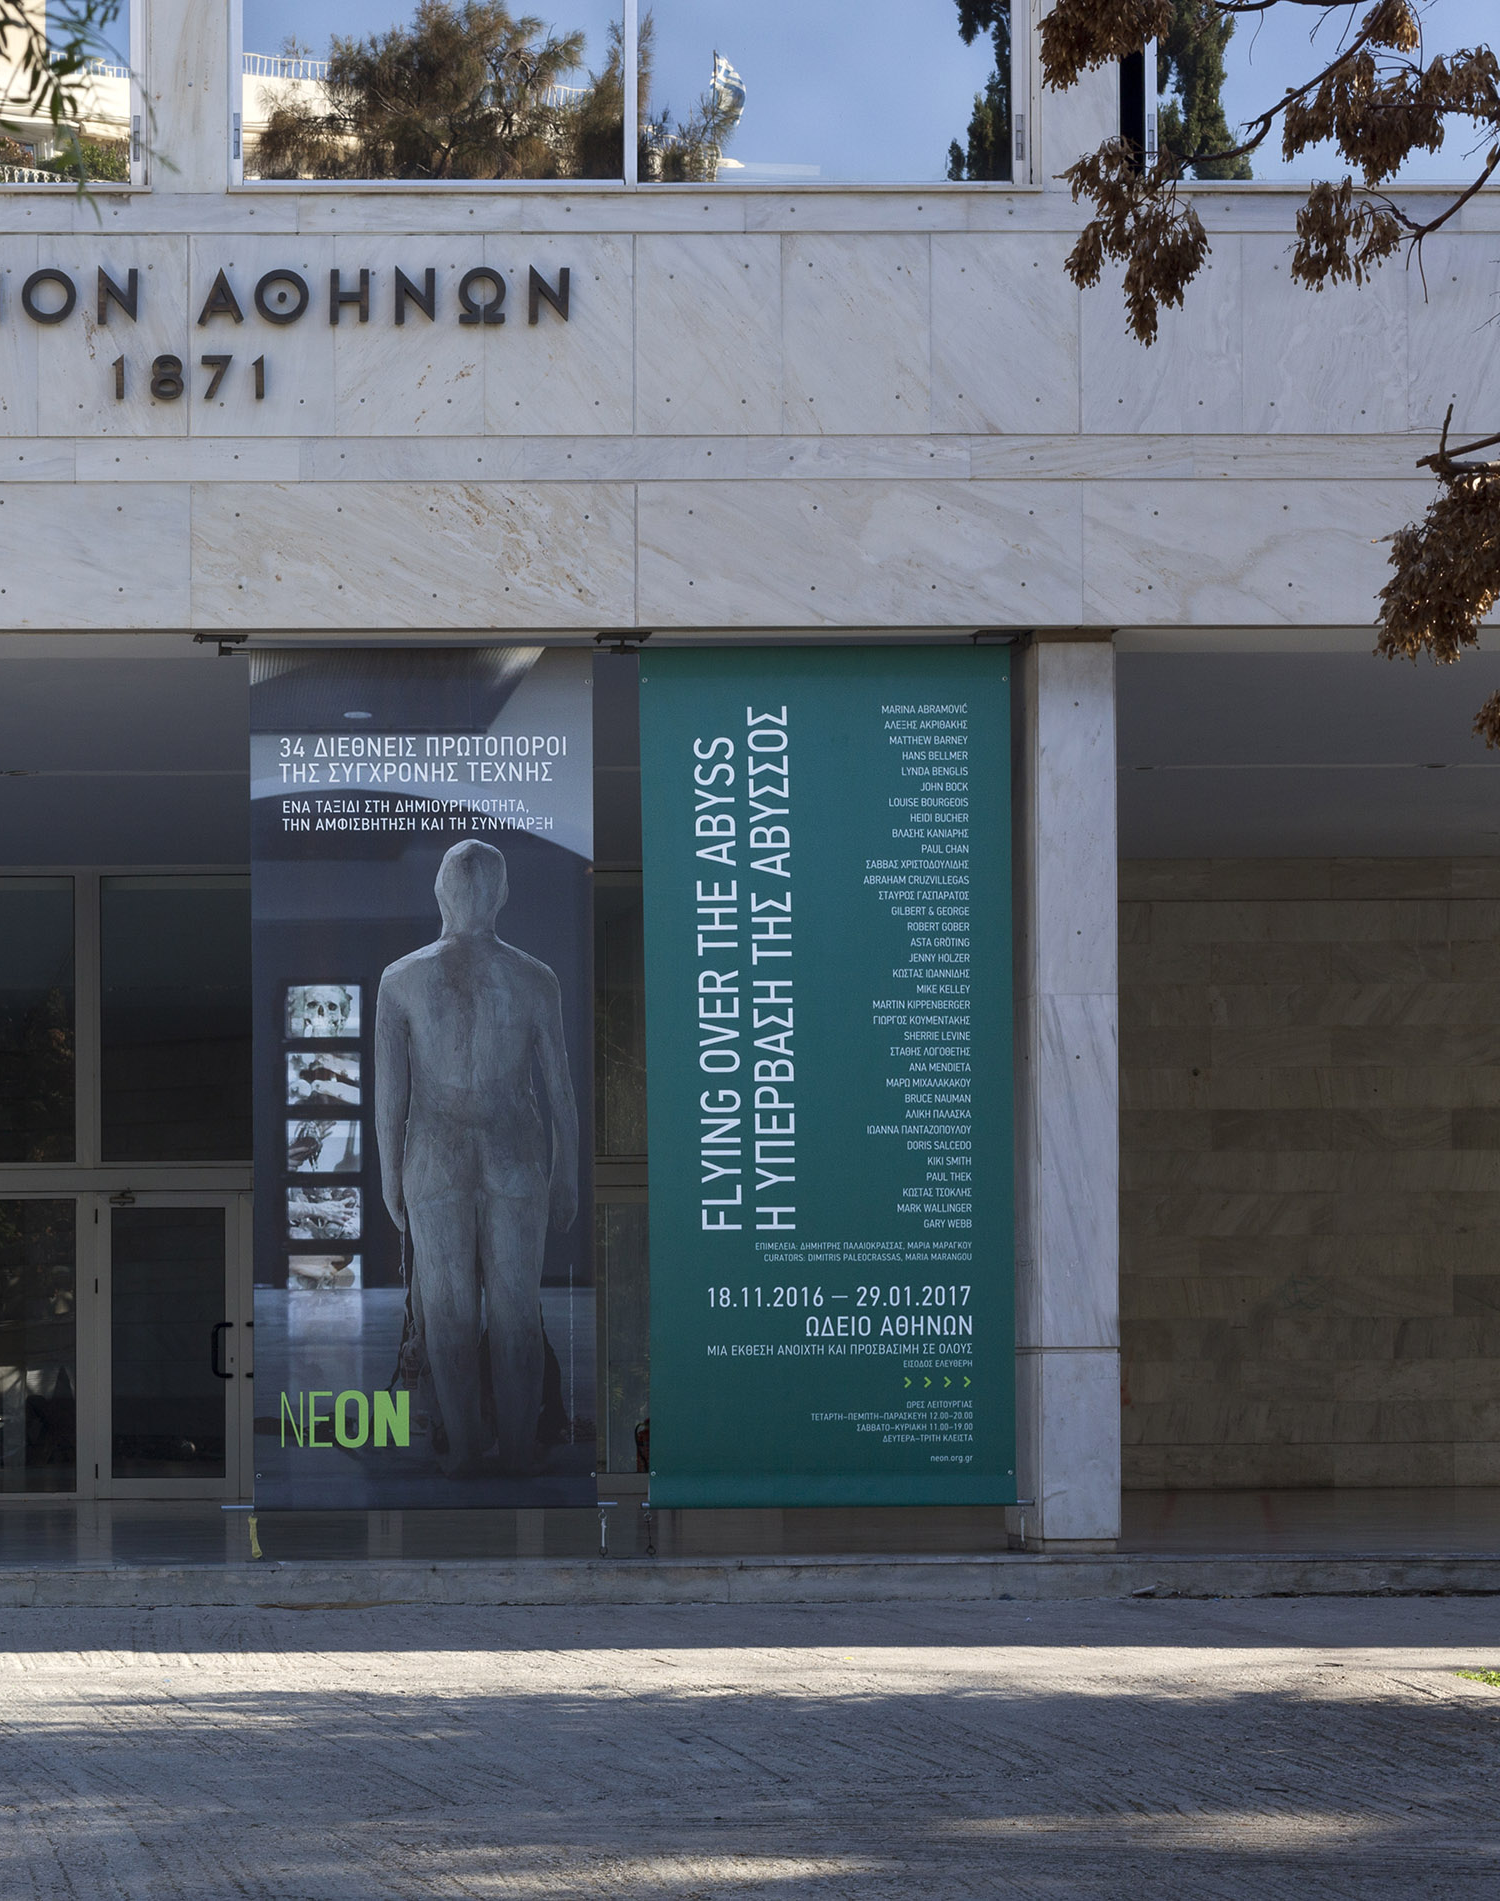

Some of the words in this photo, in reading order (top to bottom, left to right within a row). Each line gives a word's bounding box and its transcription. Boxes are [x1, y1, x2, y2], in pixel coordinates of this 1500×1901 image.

[197, 265, 570, 325] ΑΘΗΝΩΝ
[111, 354, 266, 400] 1871
[881, 704, 916, 714] MARINA
[917, 702, 968, 714] ABRAMOVIĆ
[883, 719, 918, 730] ΑΛΕΞΗΣ
[919, 719, 968, 730] ΑΚΡΙΘΑΚΗΣ
[889, 735, 932, 745] MATTHEW
[933, 735, 969, 745] BARNEY
[279, 737, 306, 758] 34
[313, 736, 417, 758] ΔΙΕΘΝΕΙΣ
[426, 735, 567, 757] ΠΡΩΤΟΠΟΡΟΙ
[902, 750, 927, 761] HANS
[928, 750, 969, 761] BELLMER
[278, 762, 321, 784] ΤΗΣ
[328, 762, 459, 783] ΣΥΓΧΡΟΝΗΣ
[466, 761, 553, 782] ΤΕΧΝΗΣ
[901, 766, 931, 777] LYNDA
[931, 766, 969, 777] BENGLIS
[747, 705, 791, 878] ΑΒΥΣΣΟΣ
[920, 781, 944, 792] JOHN
[945, 781, 969, 792] BOCK
[282, 800, 311, 814] ΕΝΑ
[315, 799, 360, 814] ΤΑΞΙΔΙ
[364, 799, 390, 813] ΣΤΗ
[394, 799, 530, 814] ΔΗΜΙΟΥΡΓΙΚΟΤΗΤΑ,
[693, 736, 736, 867] ABYSS
[888, 797, 919, 808] LOUISE
[920, 797, 969, 808] BOURGEOIS
[909, 812, 933, 823] HEIDI
[934, 812, 970, 823] BUCHER
[281, 818, 310, 832] ΤΗΝ
[315, 817, 416, 831] ΑΜΦΙΣΒΗΤΗΣΗ
[421, 817, 444, 831] ΚΑΙ
[448, 816, 467, 831] ΤΗ
[471, 816, 554, 830] ΣΥΝΥΠΑΡΞΗ
[891, 828, 925, 839] ΒΛΑΣΗΣ
[926, 828, 969, 839] ΚΑΝΙΑΡΗΣ
[921, 843, 944, 854] PAUL
[945, 844, 970, 854] CHAN
[865, 859, 899, 870] ΣΑΒΒΑΣ
[900, 859, 970, 870] ΧΡΙΣΤΟΔΟΥΛΙΔΗΣ
[863, 875, 907, 885] ABRAHAM
[907, 874, 970, 885] CRUZVILLEGAS
[878, 890, 915, 901] ΣΤΑΥΡΟΣ
[916, 890, 970, 901] ΓΑΣΠΑΡΑΤΟΣ
[890, 906, 927, 916] GILBERT
[927, 906, 935, 916] &
[936, 906, 970, 917] GEORGE
[696, 880, 738, 956] THE
[751, 892, 792, 965] ΤΗΣ
[907, 921, 940, 932] ROBERT
[941, 921, 970, 932] GOBER
[910, 937, 933, 948] ASTA
[933, 936, 971, 948] GRÖTING
[908, 953, 937, 963] JENNY
[937, 952, 971, 963] HOLZER
[892, 968, 924, 979] ΚΩΣΤΑΣ
[925, 968, 970, 979] ΙΩΑΝΝΙΔΗΣ
[916, 984, 938, 994] MIKE
[939, 984, 971, 994] KELLEY
[872, 999, 906, 1009] MARTIN
[907, 999, 971, 1010] KIPPENBERGER
[698, 969, 741, 1073] OVER
[872, 1015, 908, 1025] ΓΙΩΡΓΟΣ
[909, 1015, 971, 1026] ΚΟΥΜΕΝΤΑΚΗΣ
[903, 1030, 940, 1041] SHERRIE
[941, 1031, 971, 1041] LEVINE
[890, 1046, 922, 1057] ΣΤΑΘΗΣ
[922, 1046, 971, 1057] ΛΟΓΟΘΕΤΗΣ
[908, 1062, 928, 1072] ANA
[928, 1062, 972, 1072] MENDIETA
[753, 980, 796, 1191] ΥΠΕΡΒΑΣΗ
[885, 1077, 911, 1088] ΜΑΡΩ
[912, 1078, 972, 1088] ΜΙΧΑΛΑΚΑΚΟΥ
[904, 1093, 933, 1104] BRUCE
[934, 1093, 972, 1104] NAUMAN
[905, 1109, 932, 1119] ΑΛΙΚΗ
[932, 1109, 972, 1119] ΠΑΛΑΣΚΑ
[866, 1124, 900, 1135] ΙΩΑΝΝΑ
[901, 1124, 972, 1135] ΠΑΝΤΑΖΟΠΟΥΛΟΥ
[906, 1140, 933, 1151] DORIS
[933, 1140, 972, 1151] SALCEDO
[700, 1089, 742, 1231] FLYING
[927, 1156, 944, 1166] KIKI
[945, 1156, 972, 1166] SMITH
[926, 1171, 949, 1182] PAUL
[949, 1171, 972, 1182] THEK
[902, 1187, 934, 1198] ΚΩΣΤΑΣ
[934, 1187, 973, 1198] ΤΣΟΚΛΗΣ
[896, 1203, 922, 1213] MARK
[923, 1202, 973, 1213] WALLINGER
[755, 1206, 796, 1230] Η
[923, 1218, 946, 1229] GARY
[947, 1218, 973, 1229] WEBB
[755, 1241, 798, 1251] ΕΠΙΜΕΛΕΙΑ:
[799, 1241, 841, 1251] ΔΗΜΗΤΡΗΣ
[843, 1241, 906, 1250] ΠΑΛΑΙΟΚΡΑΣΣΑΣ,
[907, 1241, 931, 1250] ΜΑΡΙΑ
[932, 1241, 973, 1250] ΜΑΡΑΓΚΟΥ
[763, 1253, 806, 1263] CURATORS:
[807, 1253, 842, 1262] DIMITRIS
[842, 1252, 904, 1262] PALEOCRASSAS,
[904, 1252, 929, 1261] MARIA
[930, 1252, 973, 1261] MARANGOU
[707, 1286, 824, 1308] 18.11.2016
[856, 1285, 971, 1307] 29.01.2017
[805, 1315, 871, 1337] ΩΔΕΙΟ
[879, 1315, 973, 1337] ΑΘΗΝΩΝ
[707, 1345, 728, 1356] ΜΙΑ
[731, 1344, 774, 1356] ΕΚΘΕΣΗ
[776, 1343, 825, 1356] ΑΝΟΙΧΤΗ
[828, 1344, 846, 1355] ΚΑΙ
[850, 1343, 920, 1355] ΠΡΟΣΒΑΣΙΜΗ
[922, 1343, 936, 1355] ΣΕ
[938, 1342, 973, 1355] ΟΛΟΥΣ
[903, 1359, 933, 1369] ΕΙΣΟΔΟΣ
[934, 1359, 973, 1368] ΕΛΕΥΘΕΡΗ
[906, 1400, 926, 1409] ΩΡΕΣ
[926, 1399, 973, 1409] ΛΕΙΤΟΥΡΓΙΑΣ
[281, 1390, 410, 1448] NEON
[930, 1455, 974, 1464] neon.org.gr
